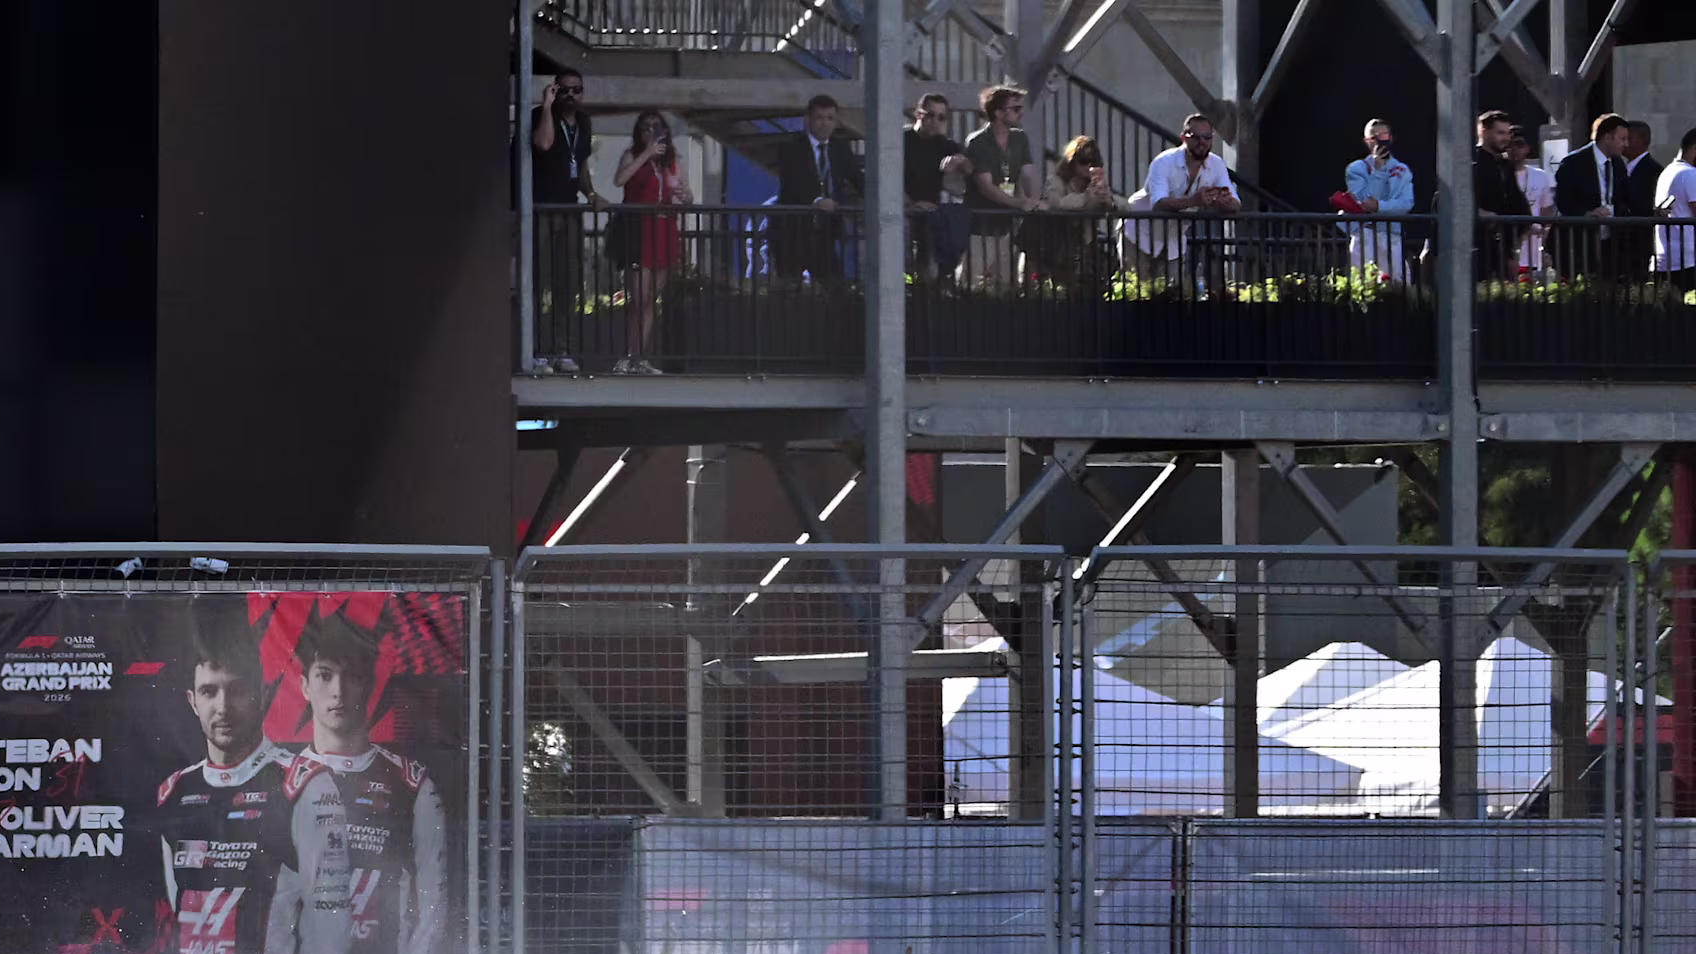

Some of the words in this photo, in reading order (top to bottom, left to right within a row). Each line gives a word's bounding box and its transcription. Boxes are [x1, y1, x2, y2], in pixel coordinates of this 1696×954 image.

[64, 636, 95, 644] QATAR
[0, 662, 113, 677] AZERBAIJAN
[1, 677, 67, 691] GRAND
[68, 676, 111, 690] PRIX
[0, 805, 125, 830] OLIVER
[345, 824, 391, 837] TOYOTA
[209, 841, 258, 850] TOYOTA
[350, 841, 384, 855] acing
[204, 850, 251, 859] GAZOO
